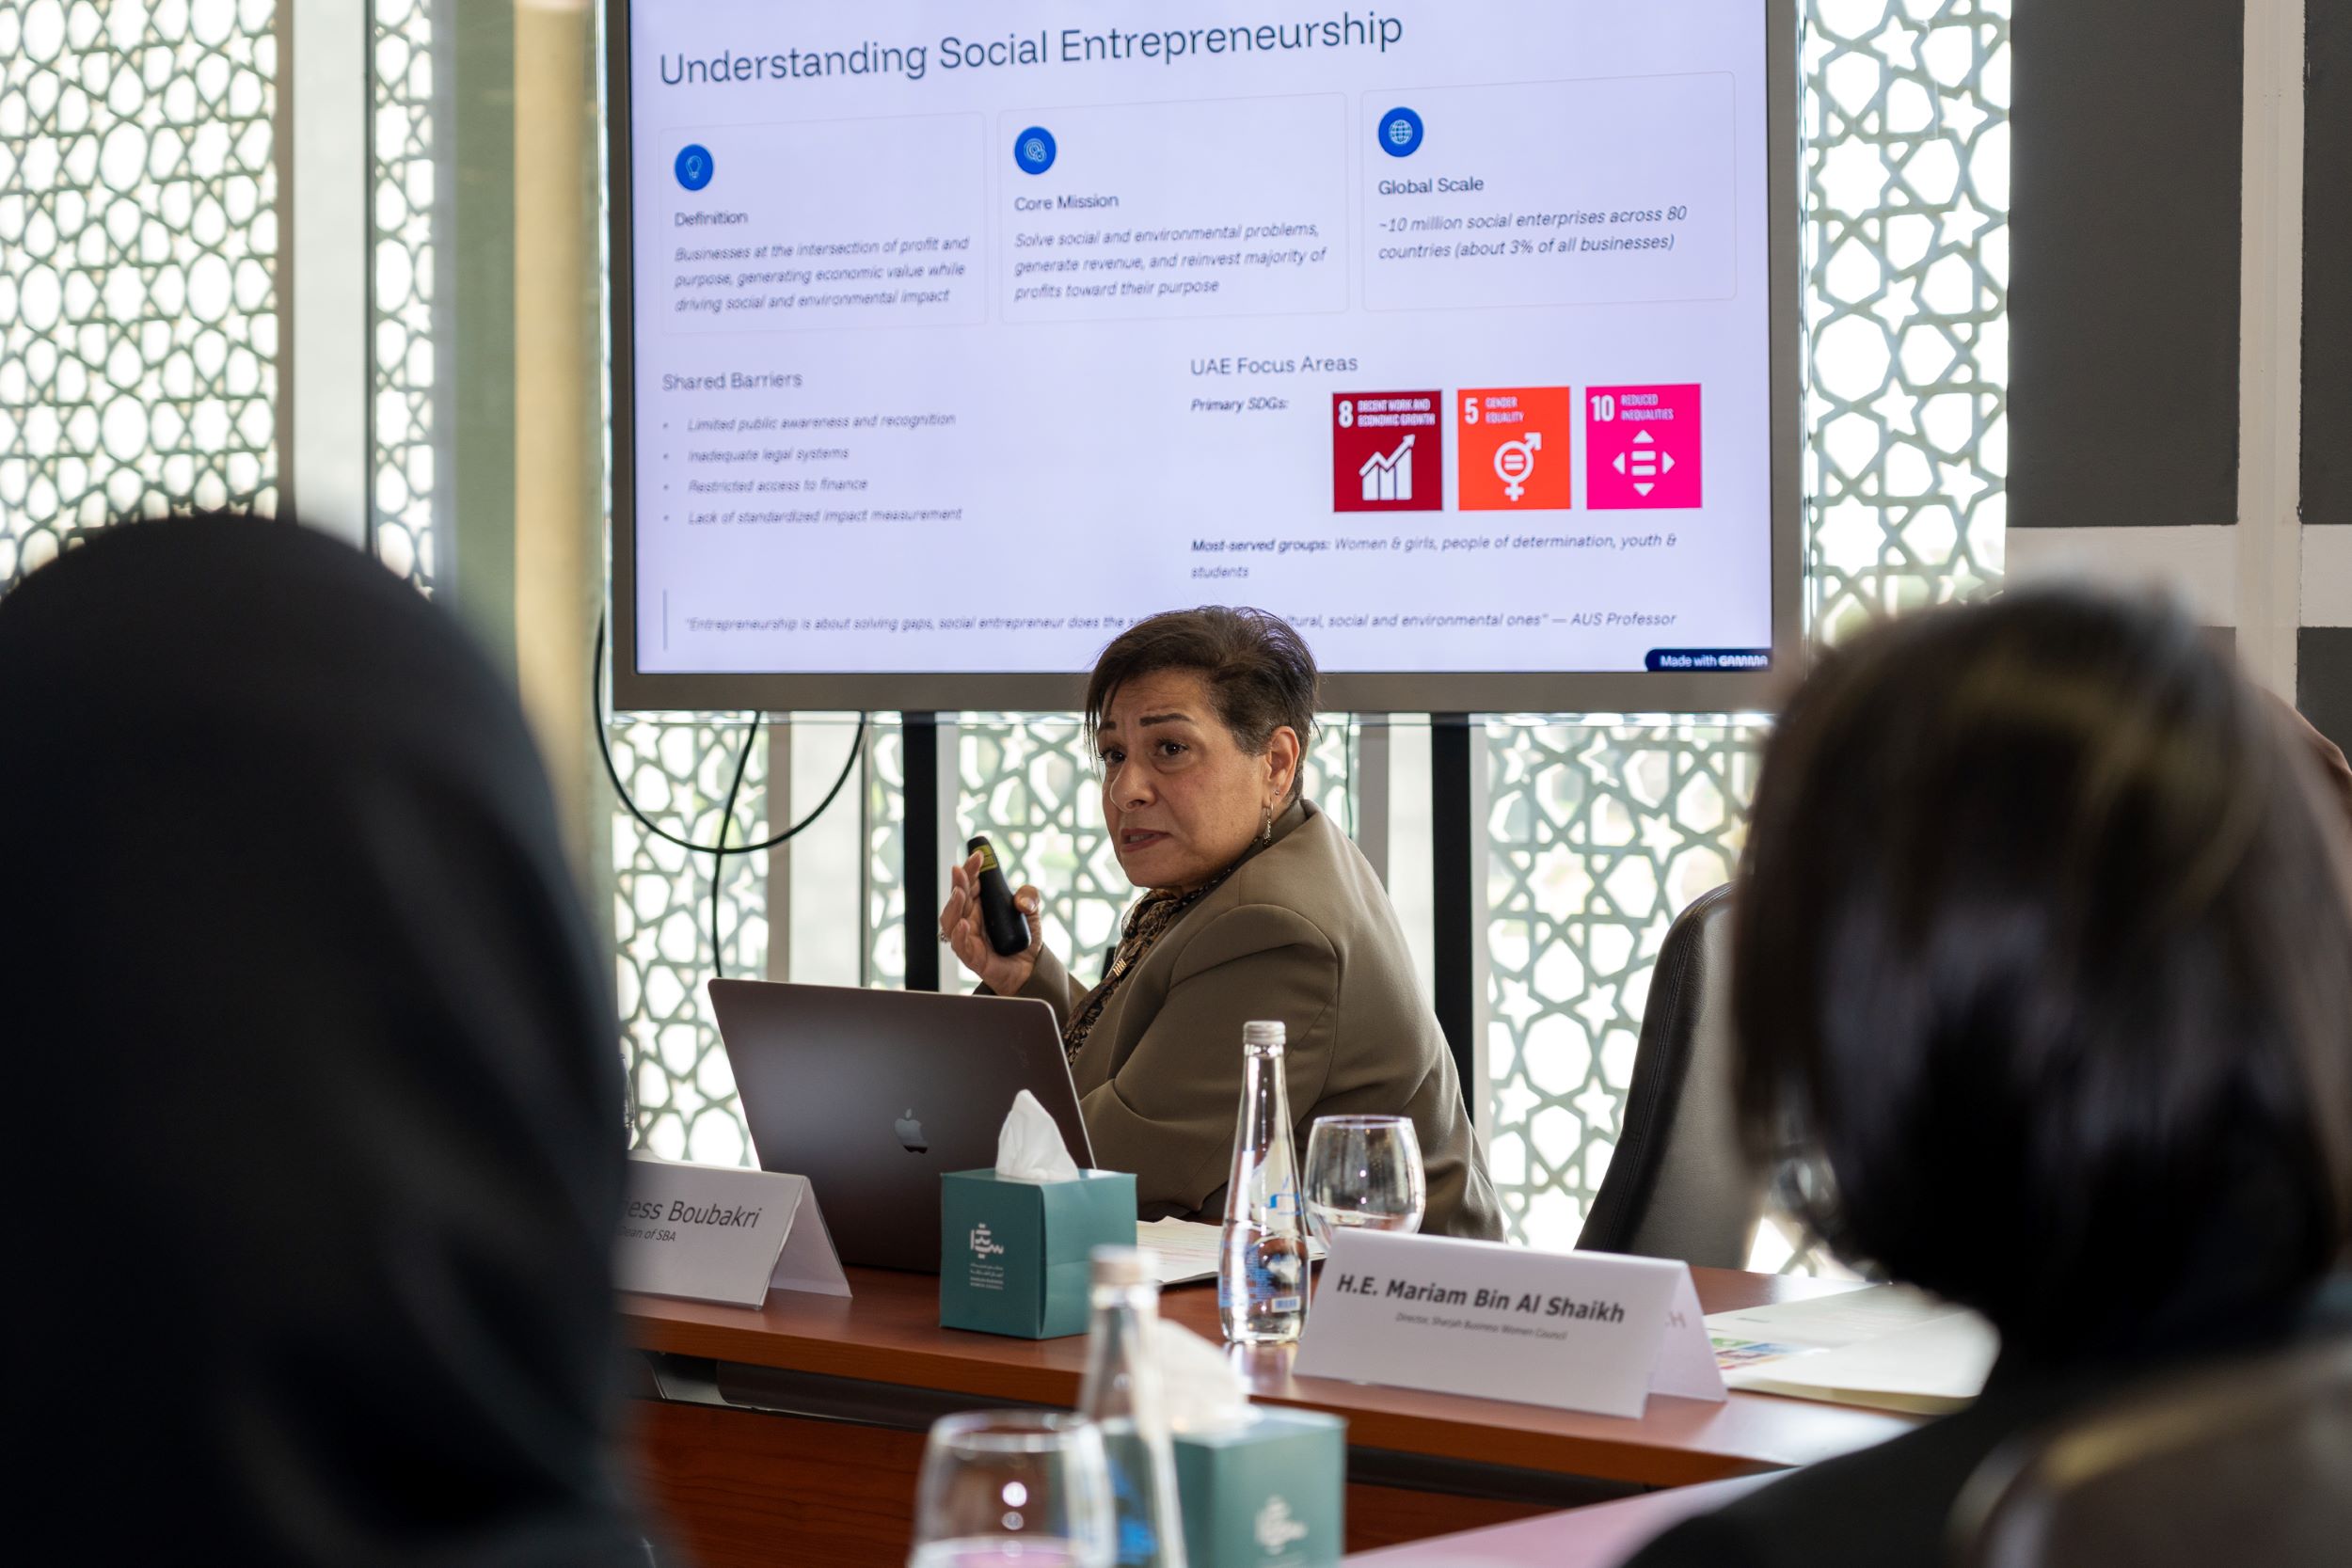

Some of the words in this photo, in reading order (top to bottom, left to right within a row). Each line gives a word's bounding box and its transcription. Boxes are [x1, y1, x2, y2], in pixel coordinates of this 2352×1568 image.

[660, 41, 927, 85] Understanding
[939, 31, 1047, 70] Social
[1061, 11, 1402, 65] Entrepreneurship
[1377, 179, 1433, 196] Global
[1438, 176, 1484, 193] Scale
[1014, 196, 1053, 212] Core
[1057, 193, 1120, 210] Mission
[675, 211, 749, 228] Definition
[1378, 217, 1407, 233] ~10
[1410, 214, 1463, 231] million
[1467, 213, 1513, 230] social
[1517, 210, 1605, 229] enterprises
[1610, 208, 1663, 224] across
[1667, 205, 1687, 221] 80
[1014, 232, 1055, 248] Solve
[1057, 230, 1101, 246] social
[1104, 229, 1131, 245] and
[1135, 225, 1242, 243] environmental
[1244, 221, 1320, 241] problems,
[675, 246, 753, 262] Businesses
[755, 245, 770, 259] at
[771, 244, 794, 259] the
[797, 241, 881, 257] intersection
[882, 237, 898, 253] of
[899, 237, 940, 256] profit
[943, 236, 970, 251] and
[1378, 243, 1452, 260] countries
[1454, 240, 1507, 259] (about
[1510, 238, 1534, 255] 3%
[1537, 237, 1556, 253] of
[1558, 237, 1578, 253] all
[1581, 233, 1675, 252] businesses)
[1014, 259, 1079, 277] generate
[1083, 256, 1146, 272] revenue,
[1150, 253, 1179, 269] and
[1181, 251, 1241, 267] reinvest
[1244, 247, 1307, 267] majority
[1311, 246, 1327, 262] of
[736, 269, 812, 288] generating
[816, 264, 882, 281] economic
[886, 263, 925, 279] value
[928, 261, 966, 277] while
[675, 296, 723, 313] driving
[725, 294, 766, 310] social
[768, 293, 795, 309] and
[799, 290, 897, 308] environmental
[900, 288, 951, 305] impact
[1014, 284, 1062, 303] profits
[1066, 281, 1118, 297] toward
[1120, 280, 1155, 296] their
[1157, 280, 1221, 298] purpose
[1190, 357, 1232, 375] UAE
[1237, 356, 1295, 374] Focus
[1301, 355, 1359, 372] Areas
[662, 372, 726, 391] Shared
[730, 371, 803, 389] Barriers
[1190, 398, 1243, 414] Primary
[1247, 396, 1289, 411] SDGs:
[1388, 399, 1412, 411] WORK
[1412, 398, 1431, 411] AND
[1485, 396, 1518, 408] GENDER
[1590, 394, 1615, 421] 10
[1620, 393, 1659, 406] REDUCED
[1338, 400, 1354, 428] 8
[1358, 414, 1399, 427] ECONOMIC
[1400, 413, 1436, 426] GROWTH
[1464, 397, 1479, 424] 5
[1485, 411, 1524, 423] EQUALITY
[1620, 408, 1674, 421] INEQUALITIES
[688, 418, 736, 433] Limited
[738, 416, 779, 433] public
[781, 415, 850, 429] awareness
[852, 413, 878, 428] and
[881, 412, 956, 431] recognition
[688, 449, 759, 465] Inadequate
[762, 447, 795, 465] legal
[797, 446, 850, 463] systems
[688, 480, 755, 494] Restricted
[756, 478, 802, 493] access
[803, 478, 818, 492] to
[819, 477, 869, 492] finance
[688, 511, 718, 526] Lack
[720, 510, 736, 525] of
[738, 508, 820, 525] standardized
[822, 507, 868, 525] impact
[870, 507, 963, 522] measurement
[1278, 538, 1330, 556] groups:
[1335, 536, 1388, 551] Women
[1391, 535, 1401, 550] &
[1405, 535, 1438, 553] girls,
[1441, 535, 1490, 551] people
[1494, 534, 1510, 549] of
[1512, 533, 1616, 549] determination,
[1620, 532, 1662, 550] youth
[1666, 533, 1677, 547] &
[1190, 565, 1249, 579] students
[814, 617, 851, 631] about
[938, 615, 977, 630] social
[977, 615, 1065, 631] entrepreneur
[1067, 614, 1100, 629] does
[1102, 613, 1125, 628] the
[1327, 612, 1369, 628] social
[1371, 612, 1397, 627] and
[1401, 612, 1504, 627] environmental
[1569, 611, 1603, 626] AUS
[1606, 611, 1677, 626] Professor
[1661, 655, 1692, 668] Made
[1693, 654, 1718, 668] with
[667, 1199, 763, 1228] Boubakri
[644, 1227, 658, 1240] of
[656, 1228, 676, 1243] SBA
[1336, 1273, 1379, 1297] H.E.
[1386, 1277, 1467, 1307] Mariam
[1473, 1288, 1510, 1311] Bin
[1516, 1292, 1542, 1315] Al
[1545, 1295, 1626, 1324] Shaikh
[1502, 1323, 1534, 1337] Women
[1534, 1326, 1569, 1341] Council
